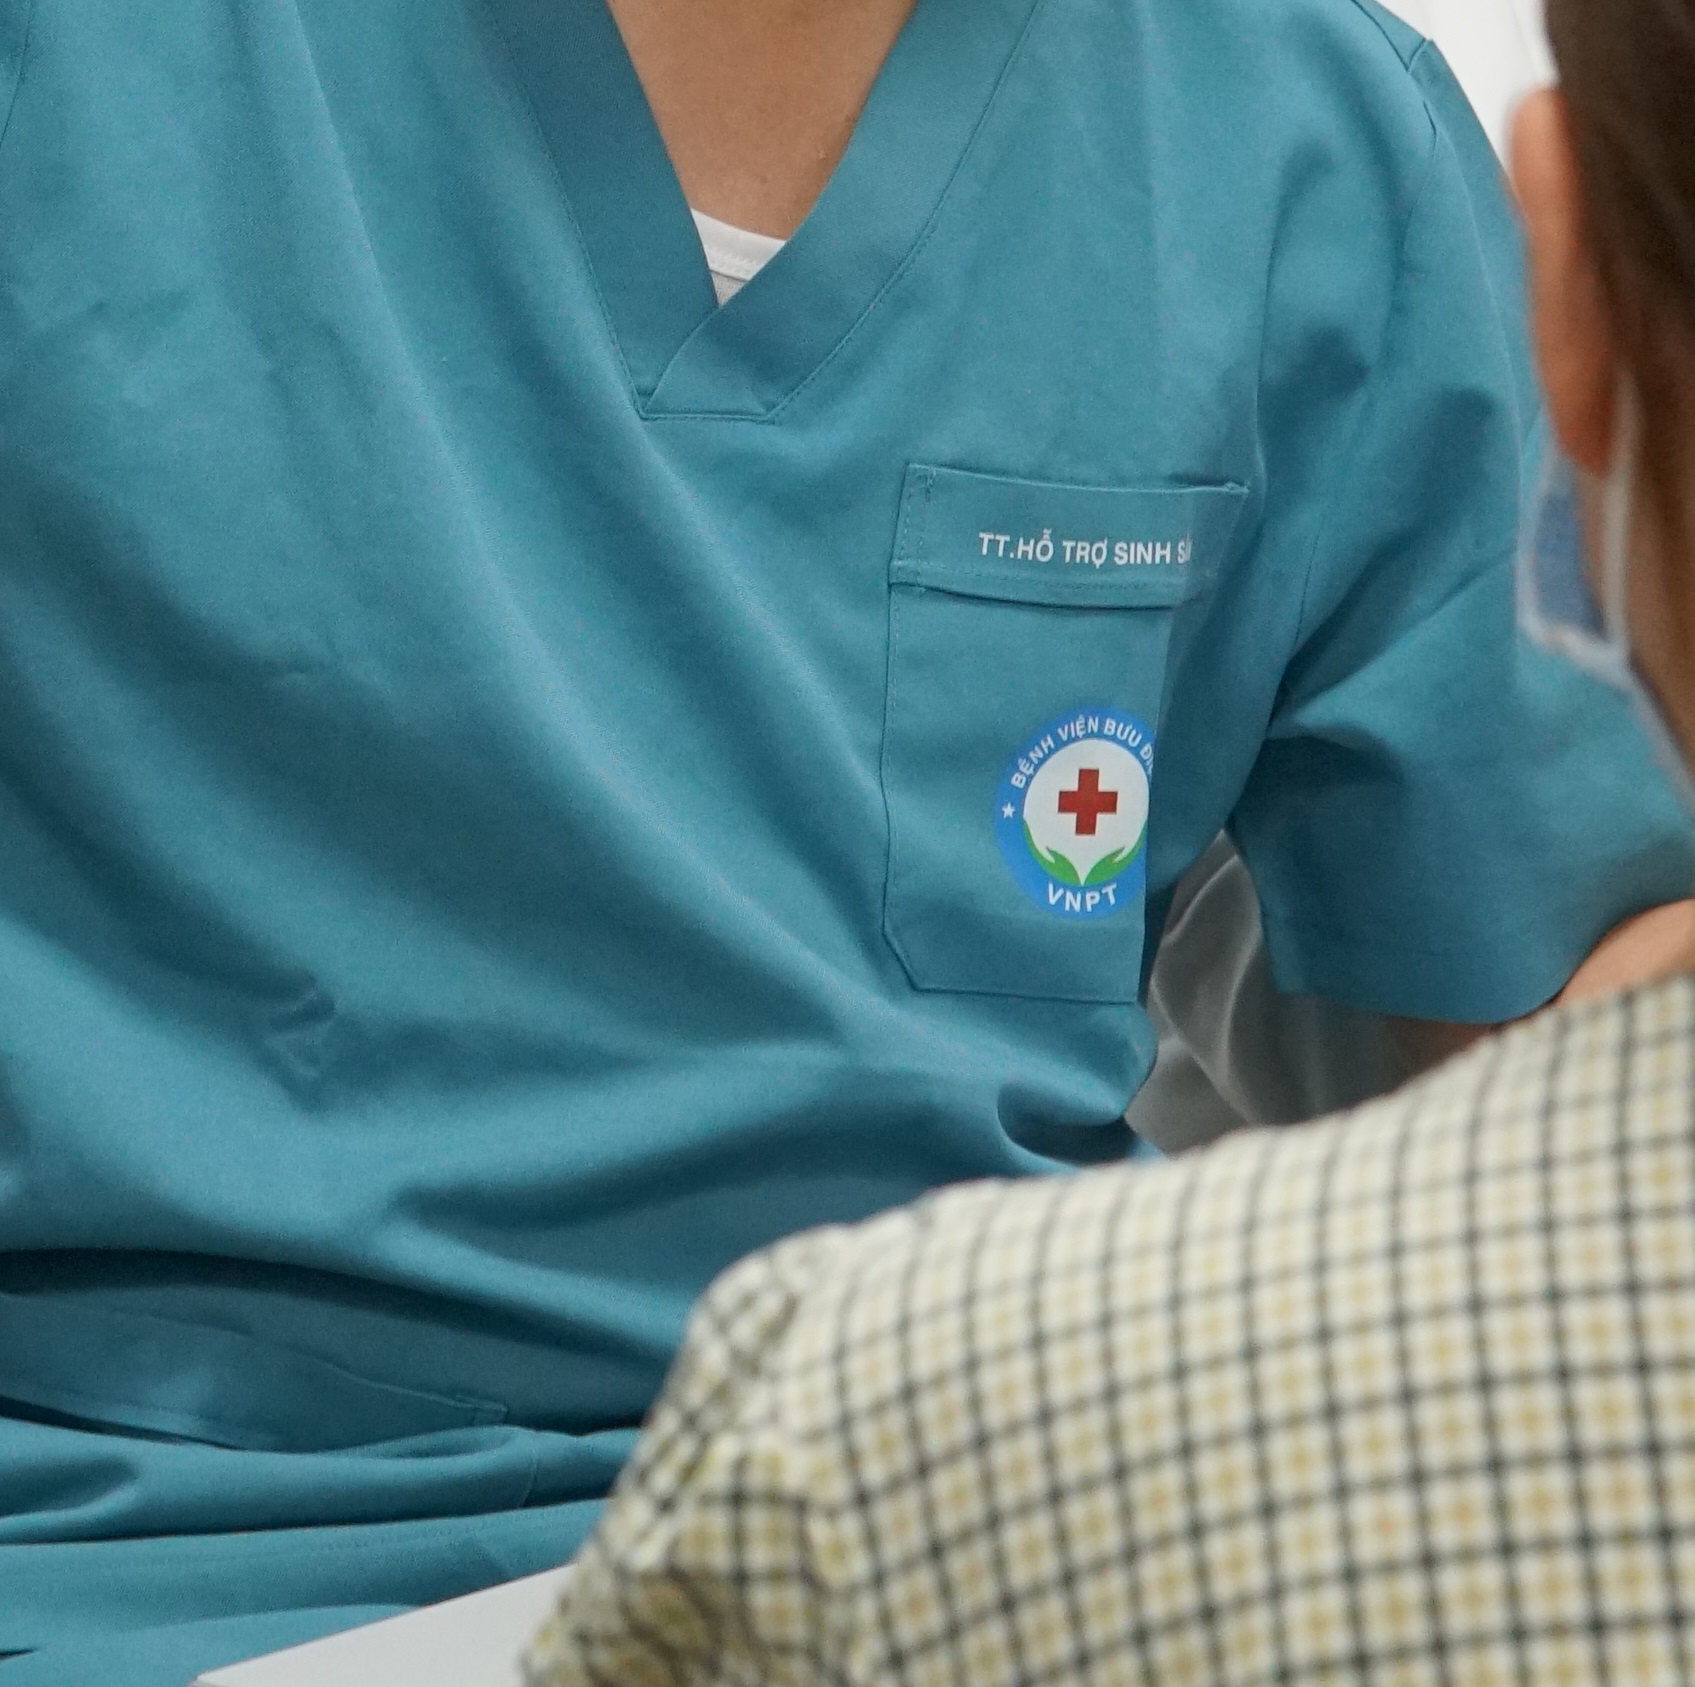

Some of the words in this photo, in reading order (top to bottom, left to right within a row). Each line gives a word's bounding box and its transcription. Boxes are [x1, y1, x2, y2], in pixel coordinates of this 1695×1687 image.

[978, 528, 1055, 563] TT.HỖ
[1062, 538, 1109, 570] TRỢ
[1113, 541, 1172, 566] SINH
[1010, 733, 1055, 790] BỆNH
[1057, 714, 1100, 743] VIỆN
[1103, 717, 1143, 748] BƯU
[1046, 881, 1119, 914] VNPT
